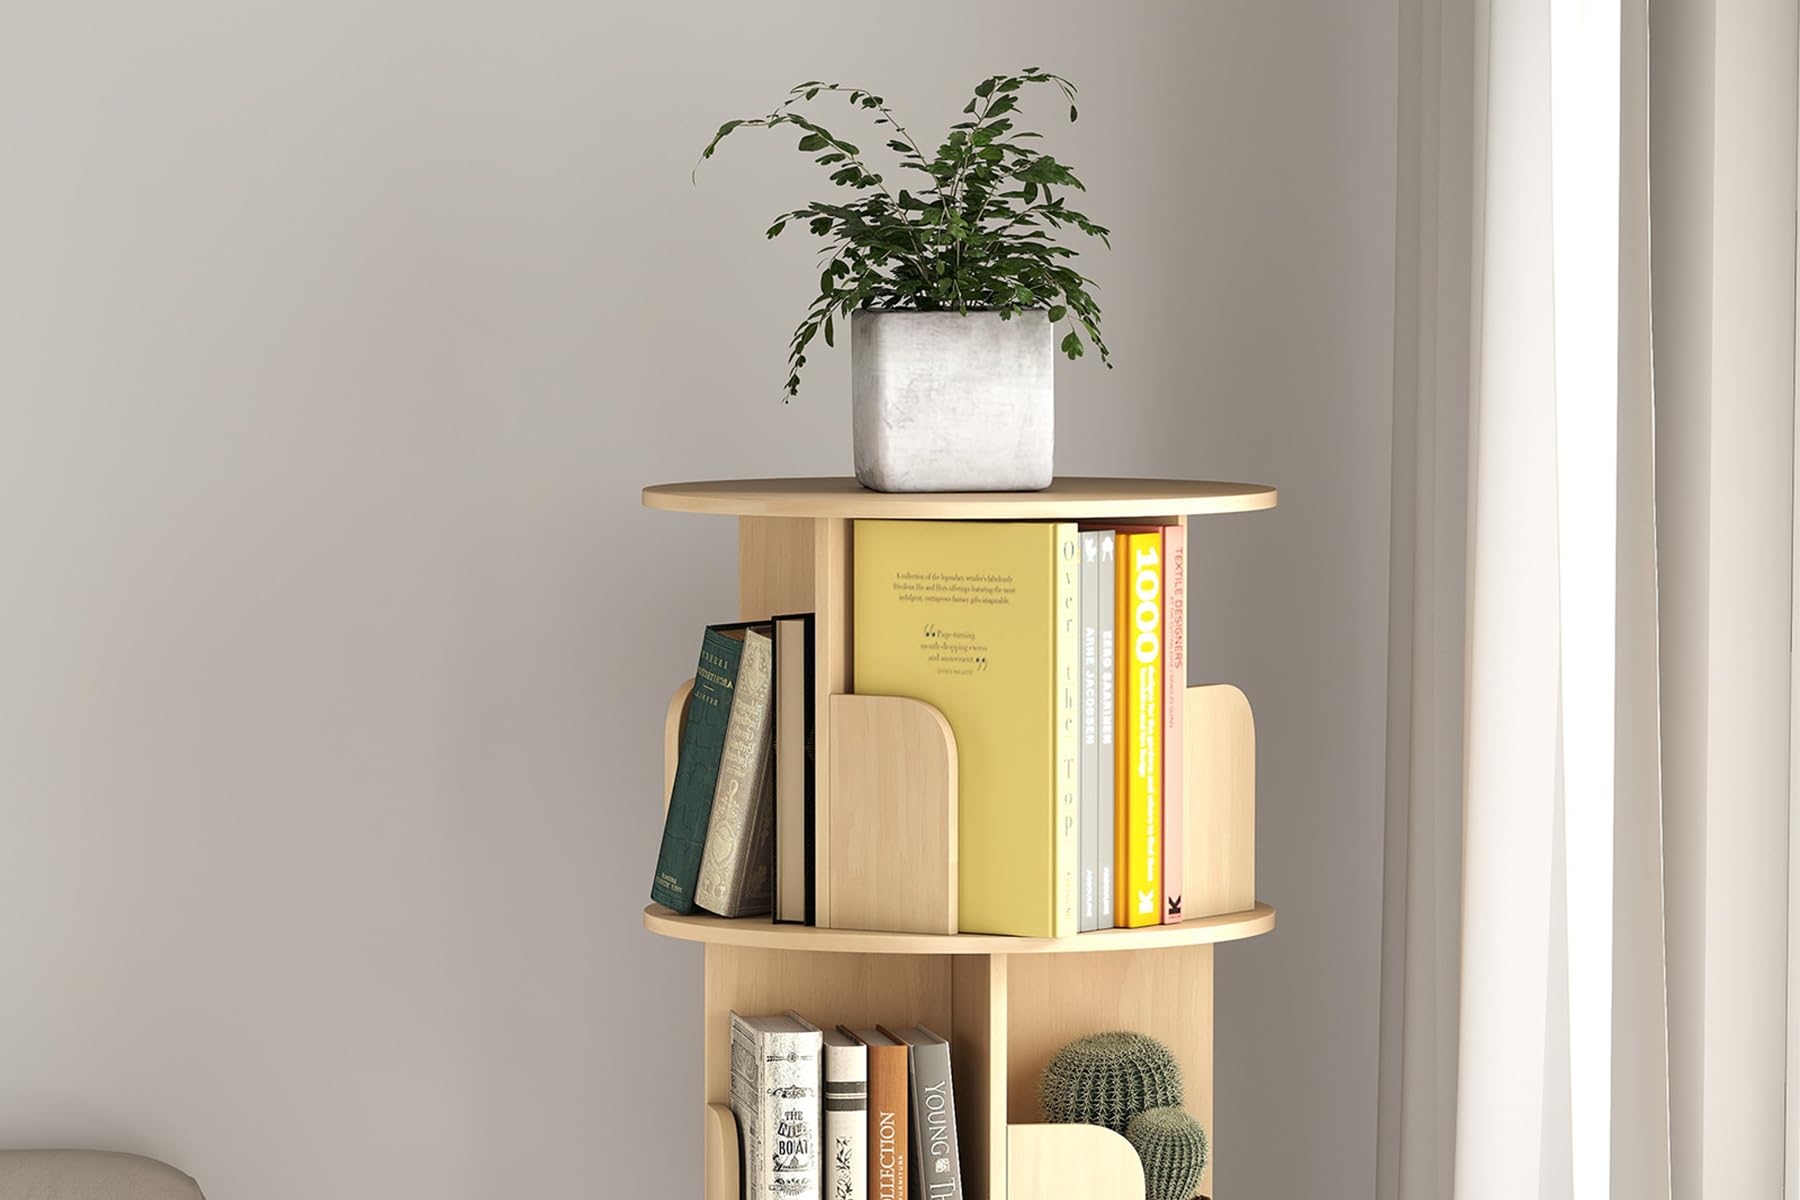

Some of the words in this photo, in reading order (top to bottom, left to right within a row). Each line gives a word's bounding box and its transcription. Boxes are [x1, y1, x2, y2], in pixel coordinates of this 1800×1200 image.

[1063, 540, 1075, 633] Over
[1135, 546, 1159, 663] 1000
[1174, 547, 1183, 596] TEXTILE
[1174, 599, 1183, 669] DESIGNERS
[1064, 664, 1073, 732] the
[779, 1139, 809, 1156] BOAT
[784, 1111, 804, 1121] THE
[924, 1080, 950, 1157] YOUNG
